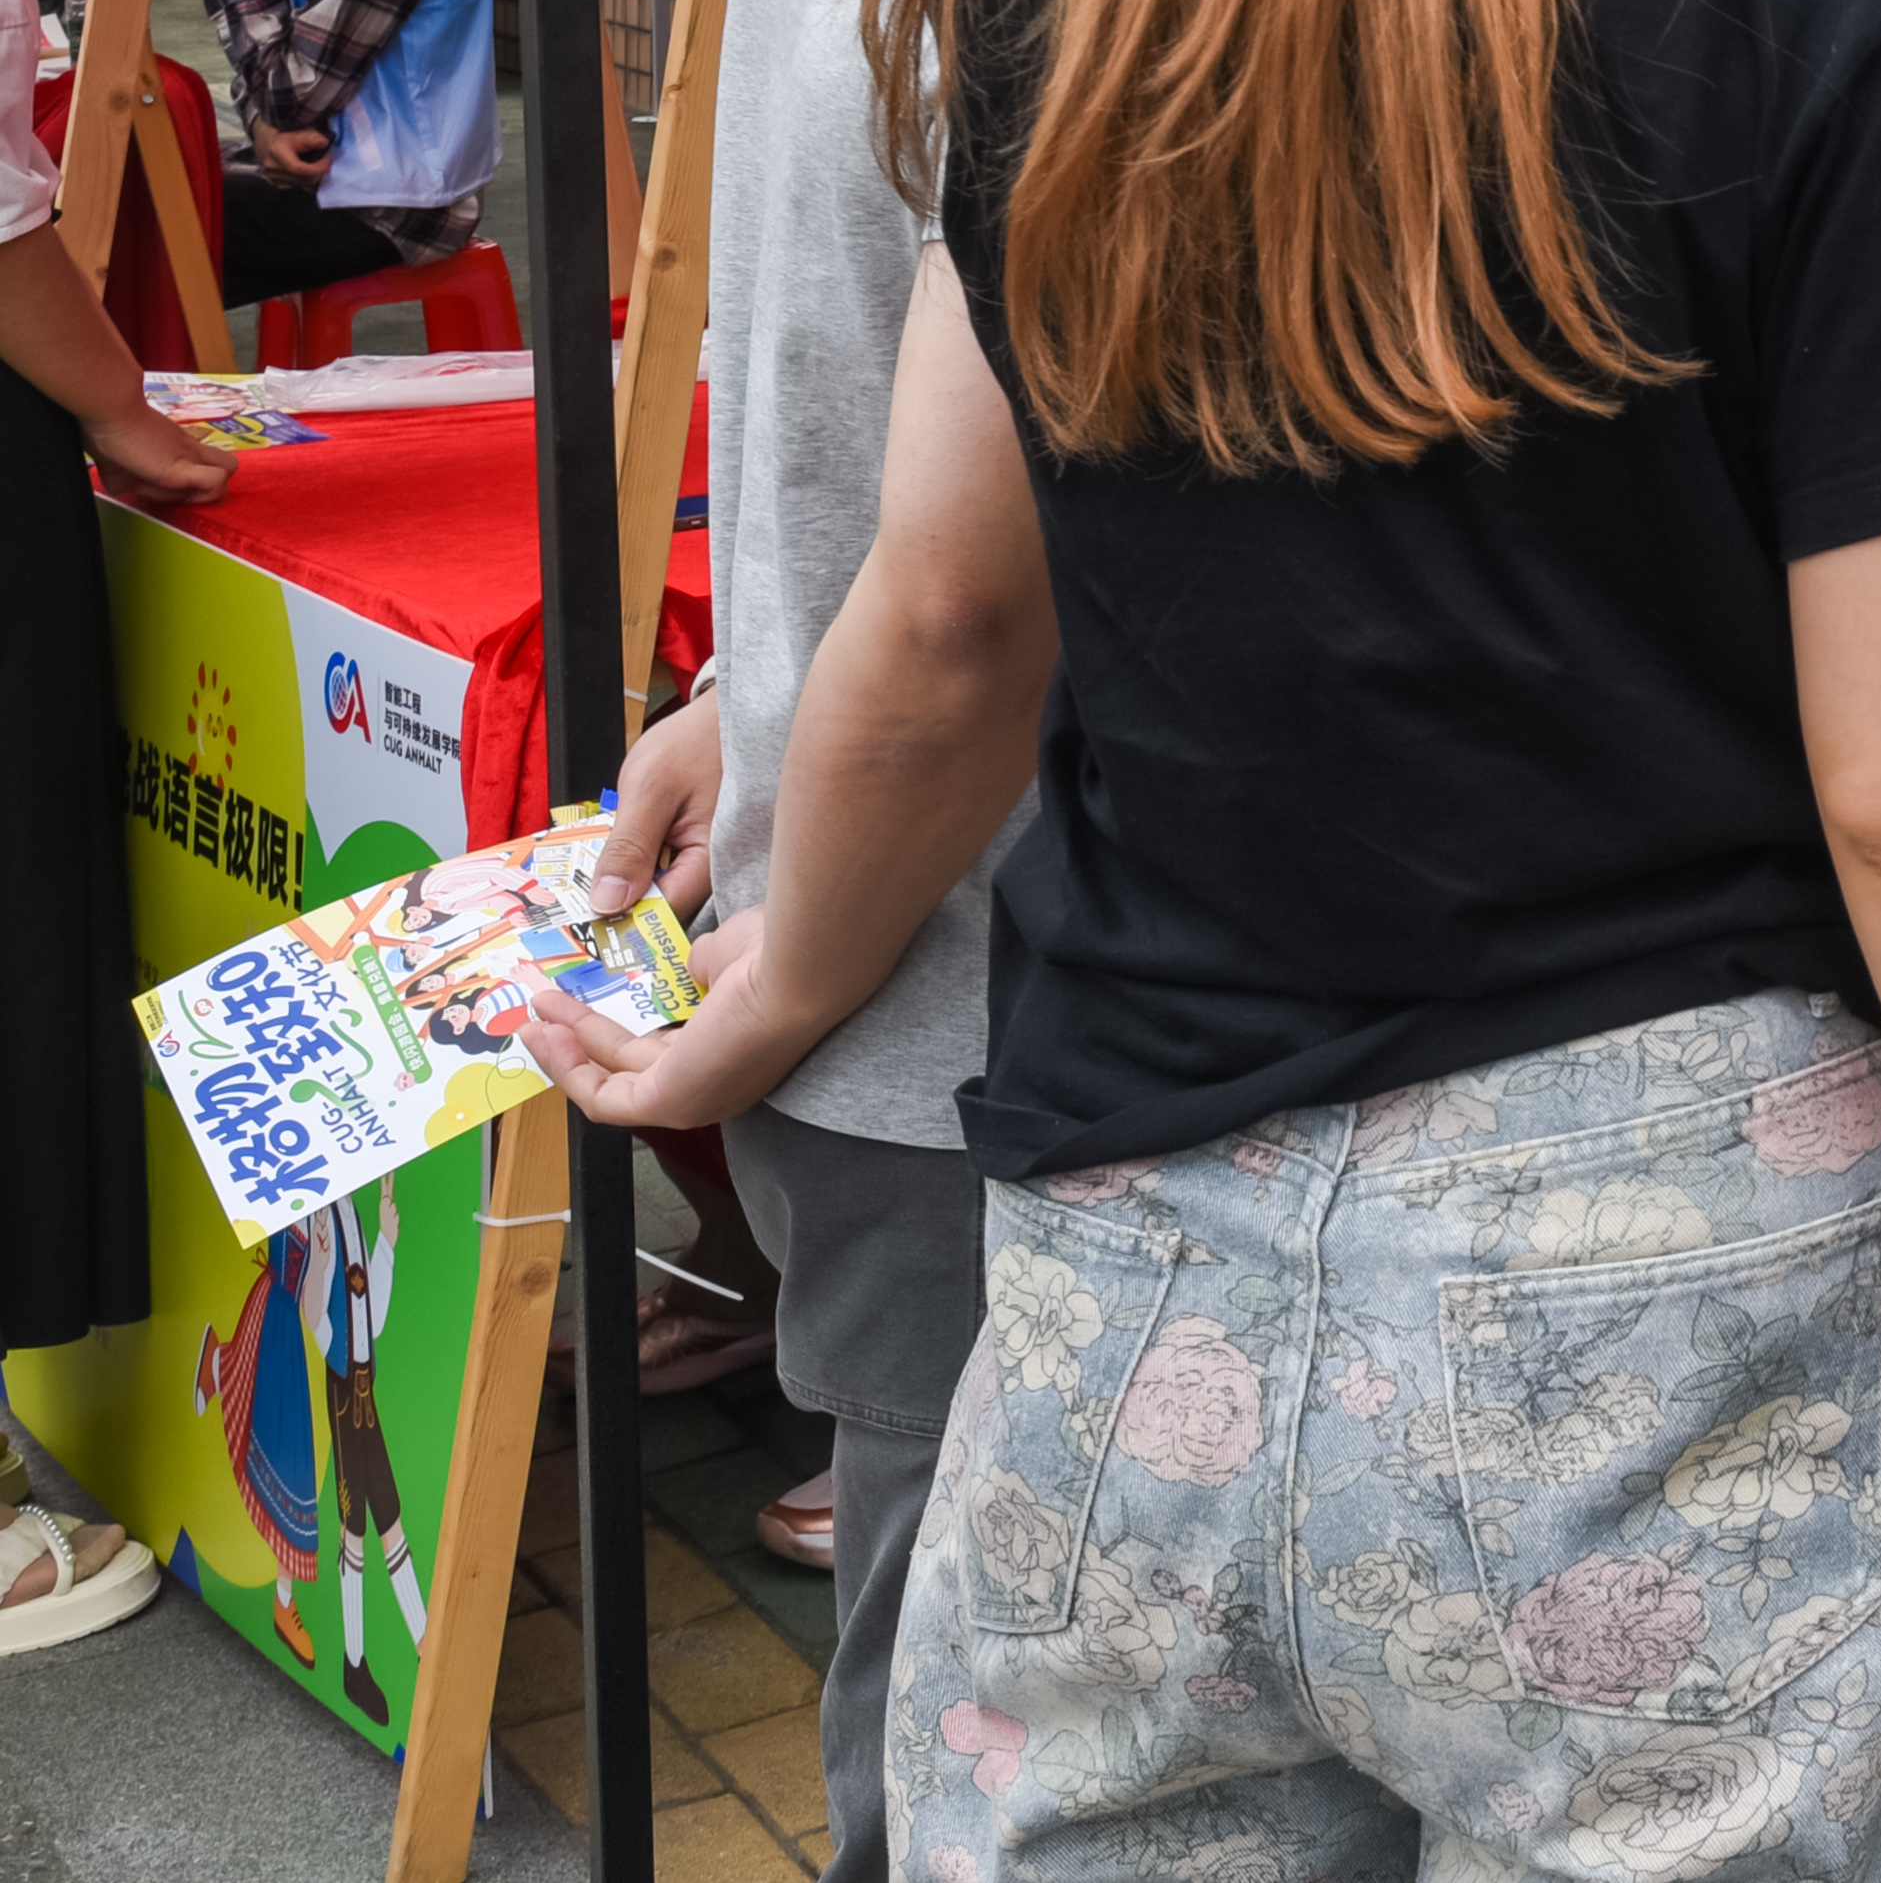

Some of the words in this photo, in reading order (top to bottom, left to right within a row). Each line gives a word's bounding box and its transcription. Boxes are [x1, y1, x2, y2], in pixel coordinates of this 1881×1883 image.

[384, 734, 403, 757] CUG
[405, 746, 442, 774] ANHALT
[278, 941, 348, 1011] 文化节
[638, 908, 700, 1007] Kulturfestival
[322, 1066, 397, 1147] ANHALT
